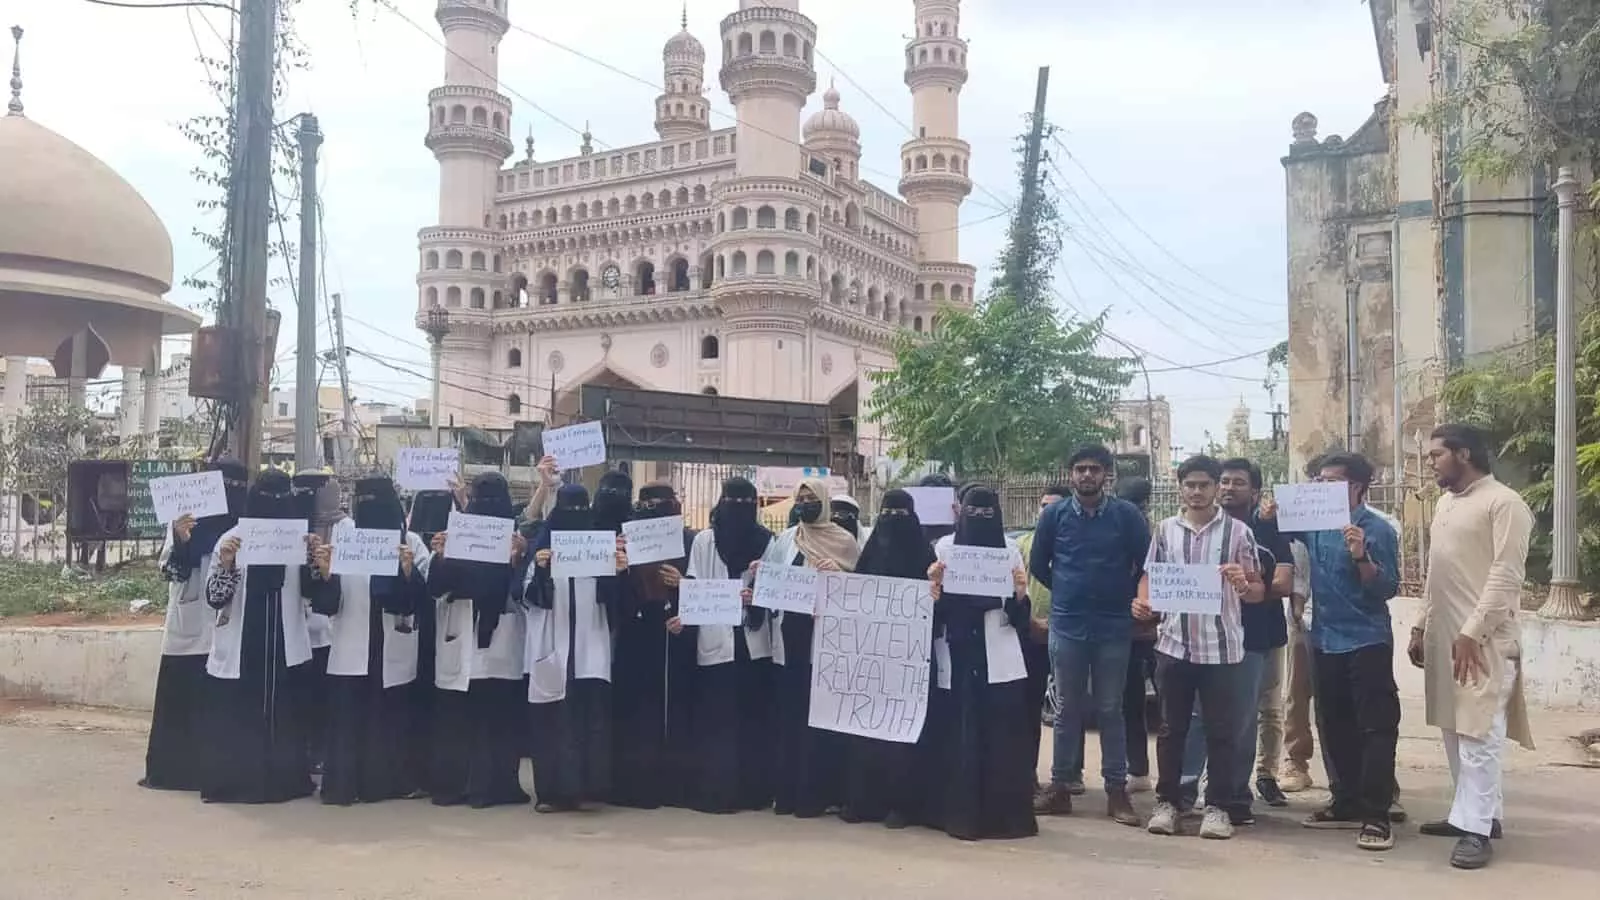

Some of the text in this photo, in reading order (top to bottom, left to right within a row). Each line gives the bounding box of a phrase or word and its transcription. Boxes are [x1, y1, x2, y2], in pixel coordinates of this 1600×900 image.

[825, 575, 933, 619] RECHECK
[821, 615, 928, 662] REVIEW
[816, 652, 929, 698] REVEAL THE
[831, 691, 919, 736] TRUTH
